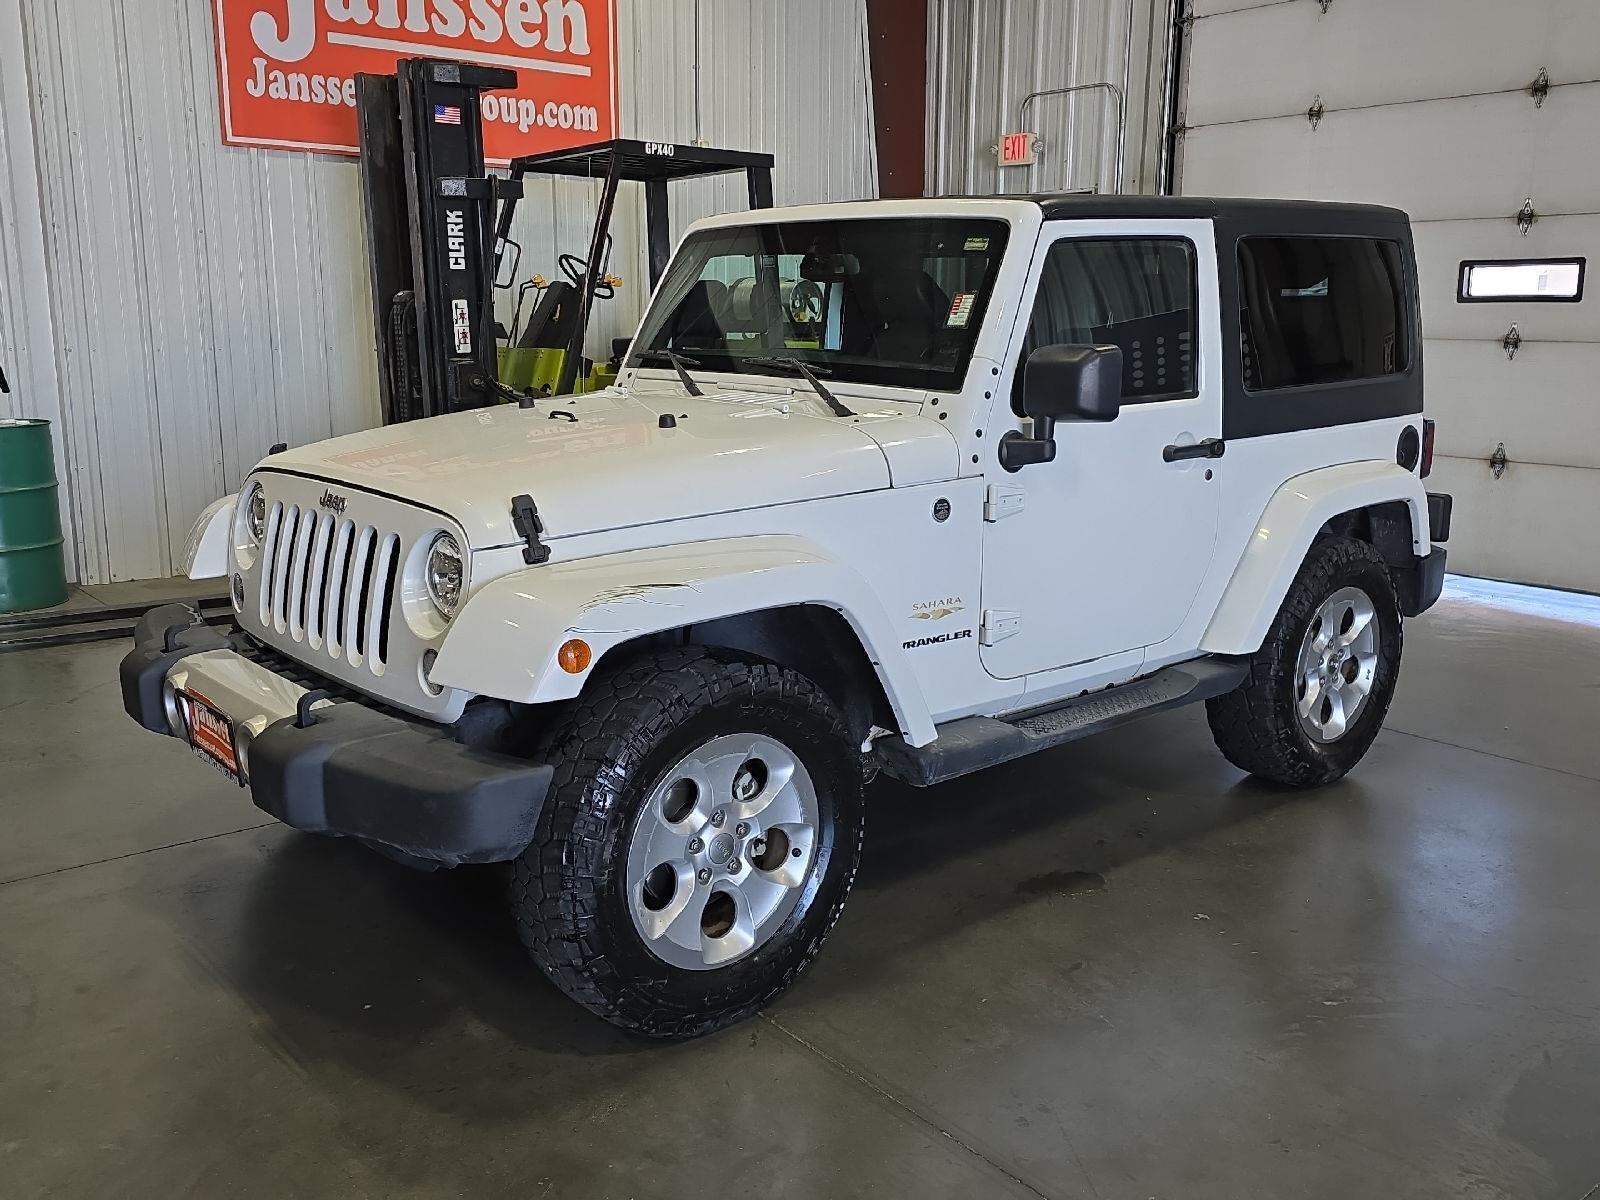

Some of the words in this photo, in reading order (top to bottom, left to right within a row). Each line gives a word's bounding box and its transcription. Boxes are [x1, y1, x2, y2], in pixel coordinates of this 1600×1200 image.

[645, 142, 674, 157] GPX40
[1004, 134, 1027, 161] EXIT
[446, 209, 466, 270] CLARK
[320, 488, 347, 516] Jeep
[912, 596, 962, 611] SAHARA
